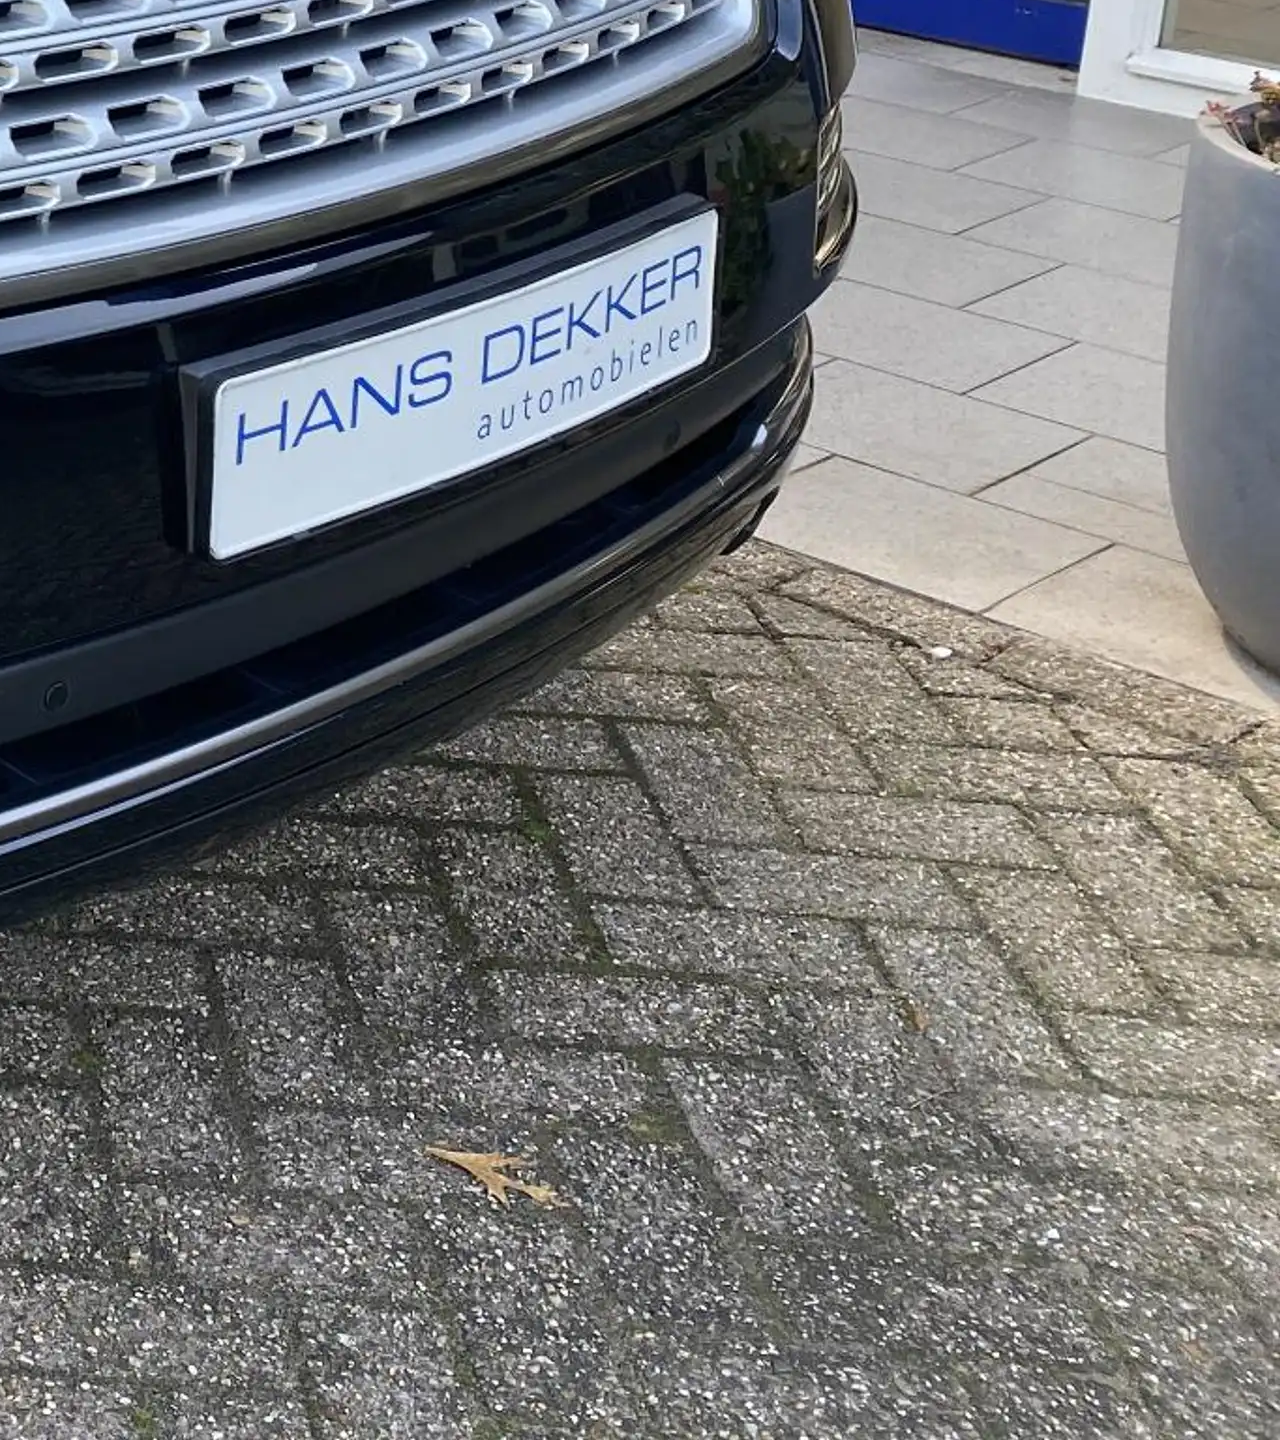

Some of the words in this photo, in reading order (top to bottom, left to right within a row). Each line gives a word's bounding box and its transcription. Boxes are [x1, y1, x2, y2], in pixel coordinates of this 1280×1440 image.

[236, 350, 453, 465] HANS
[481, 245, 703, 384] DEKKER
[477, 319, 698, 440] automobielen
